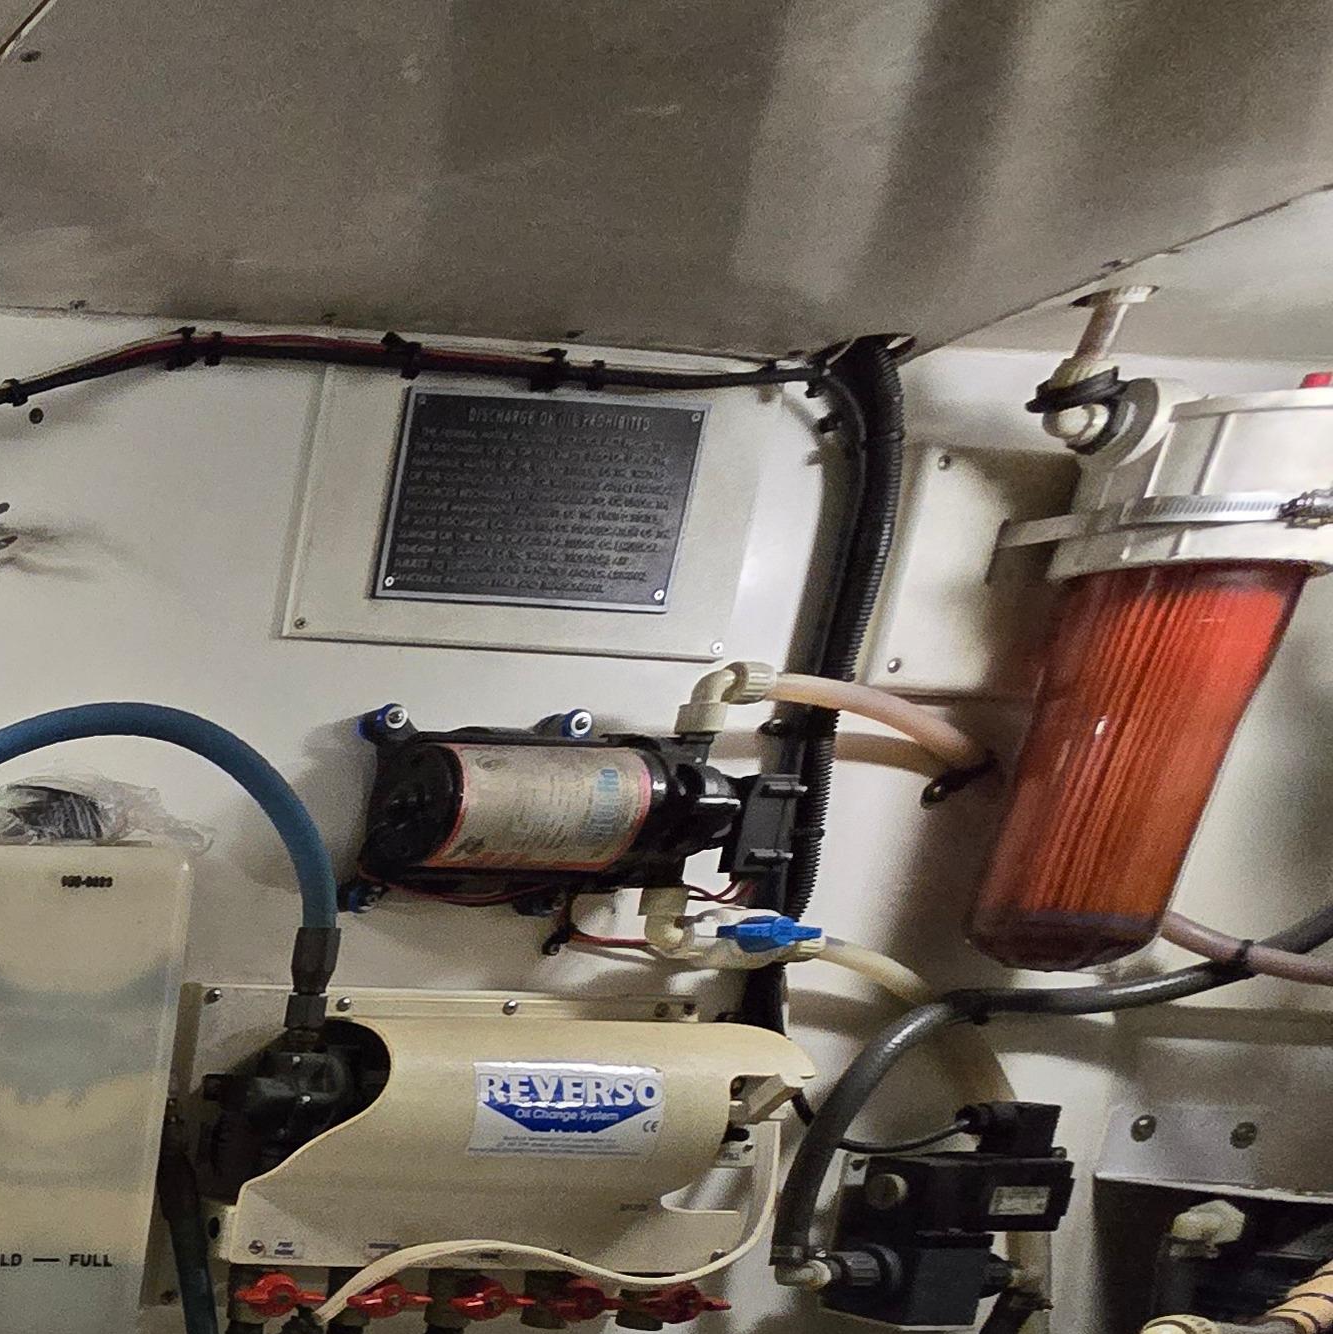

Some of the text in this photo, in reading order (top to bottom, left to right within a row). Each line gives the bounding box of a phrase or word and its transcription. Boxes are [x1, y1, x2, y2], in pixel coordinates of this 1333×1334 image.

[478, 1073, 664, 1107] REVERSO
[514, 1108, 620, 1122] Oil Change System
[69, 1253, 113, 1268] FULL
